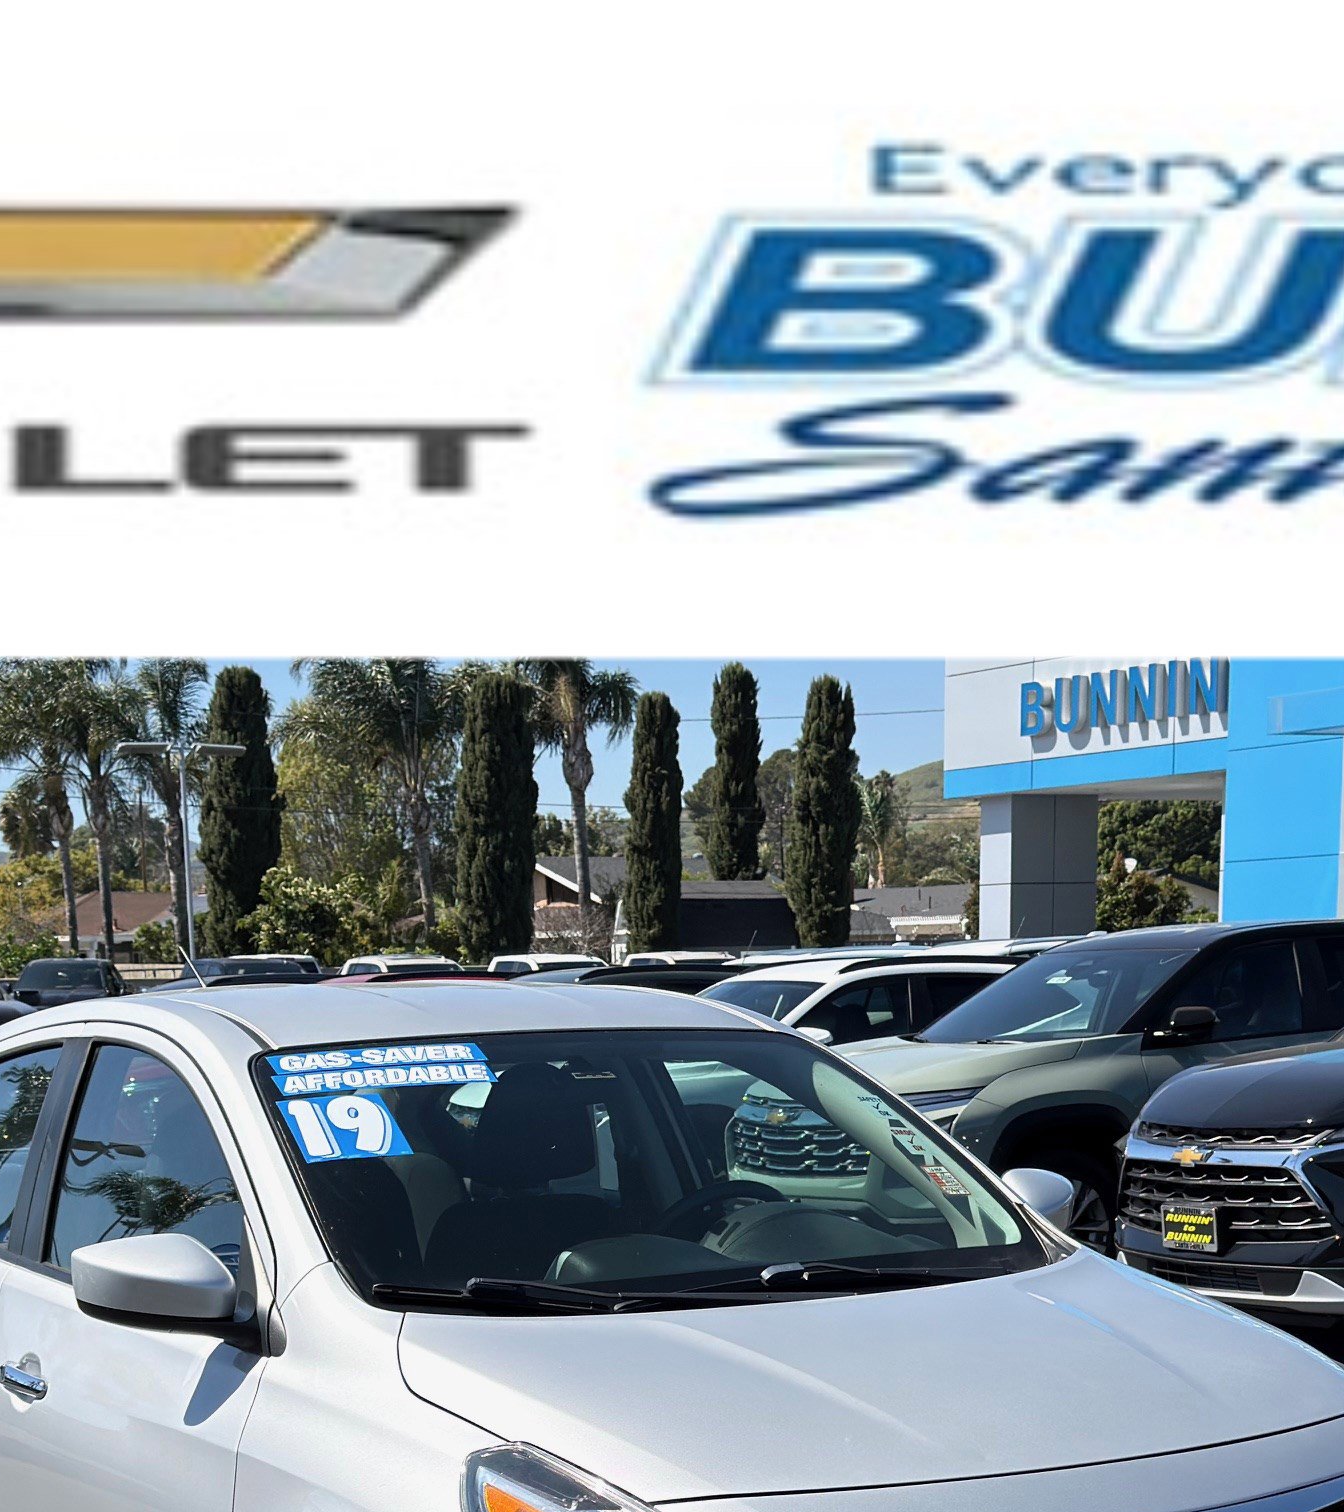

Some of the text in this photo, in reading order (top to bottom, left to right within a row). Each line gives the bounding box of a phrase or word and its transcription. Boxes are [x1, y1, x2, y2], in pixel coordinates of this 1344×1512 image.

[1019, 656, 1229, 737] BUNNIN
[279, 1043, 474, 1071] GAS-SAVER
[283, 1063, 491, 1095] AFFORDABLE
[287, 1095, 394, 1159] 19
[1165, 1213, 1214, 1226] RUNNIN'
[1183, 1224, 1196, 1232] to
[1165, 1231, 1213, 1244] BUNNIN
